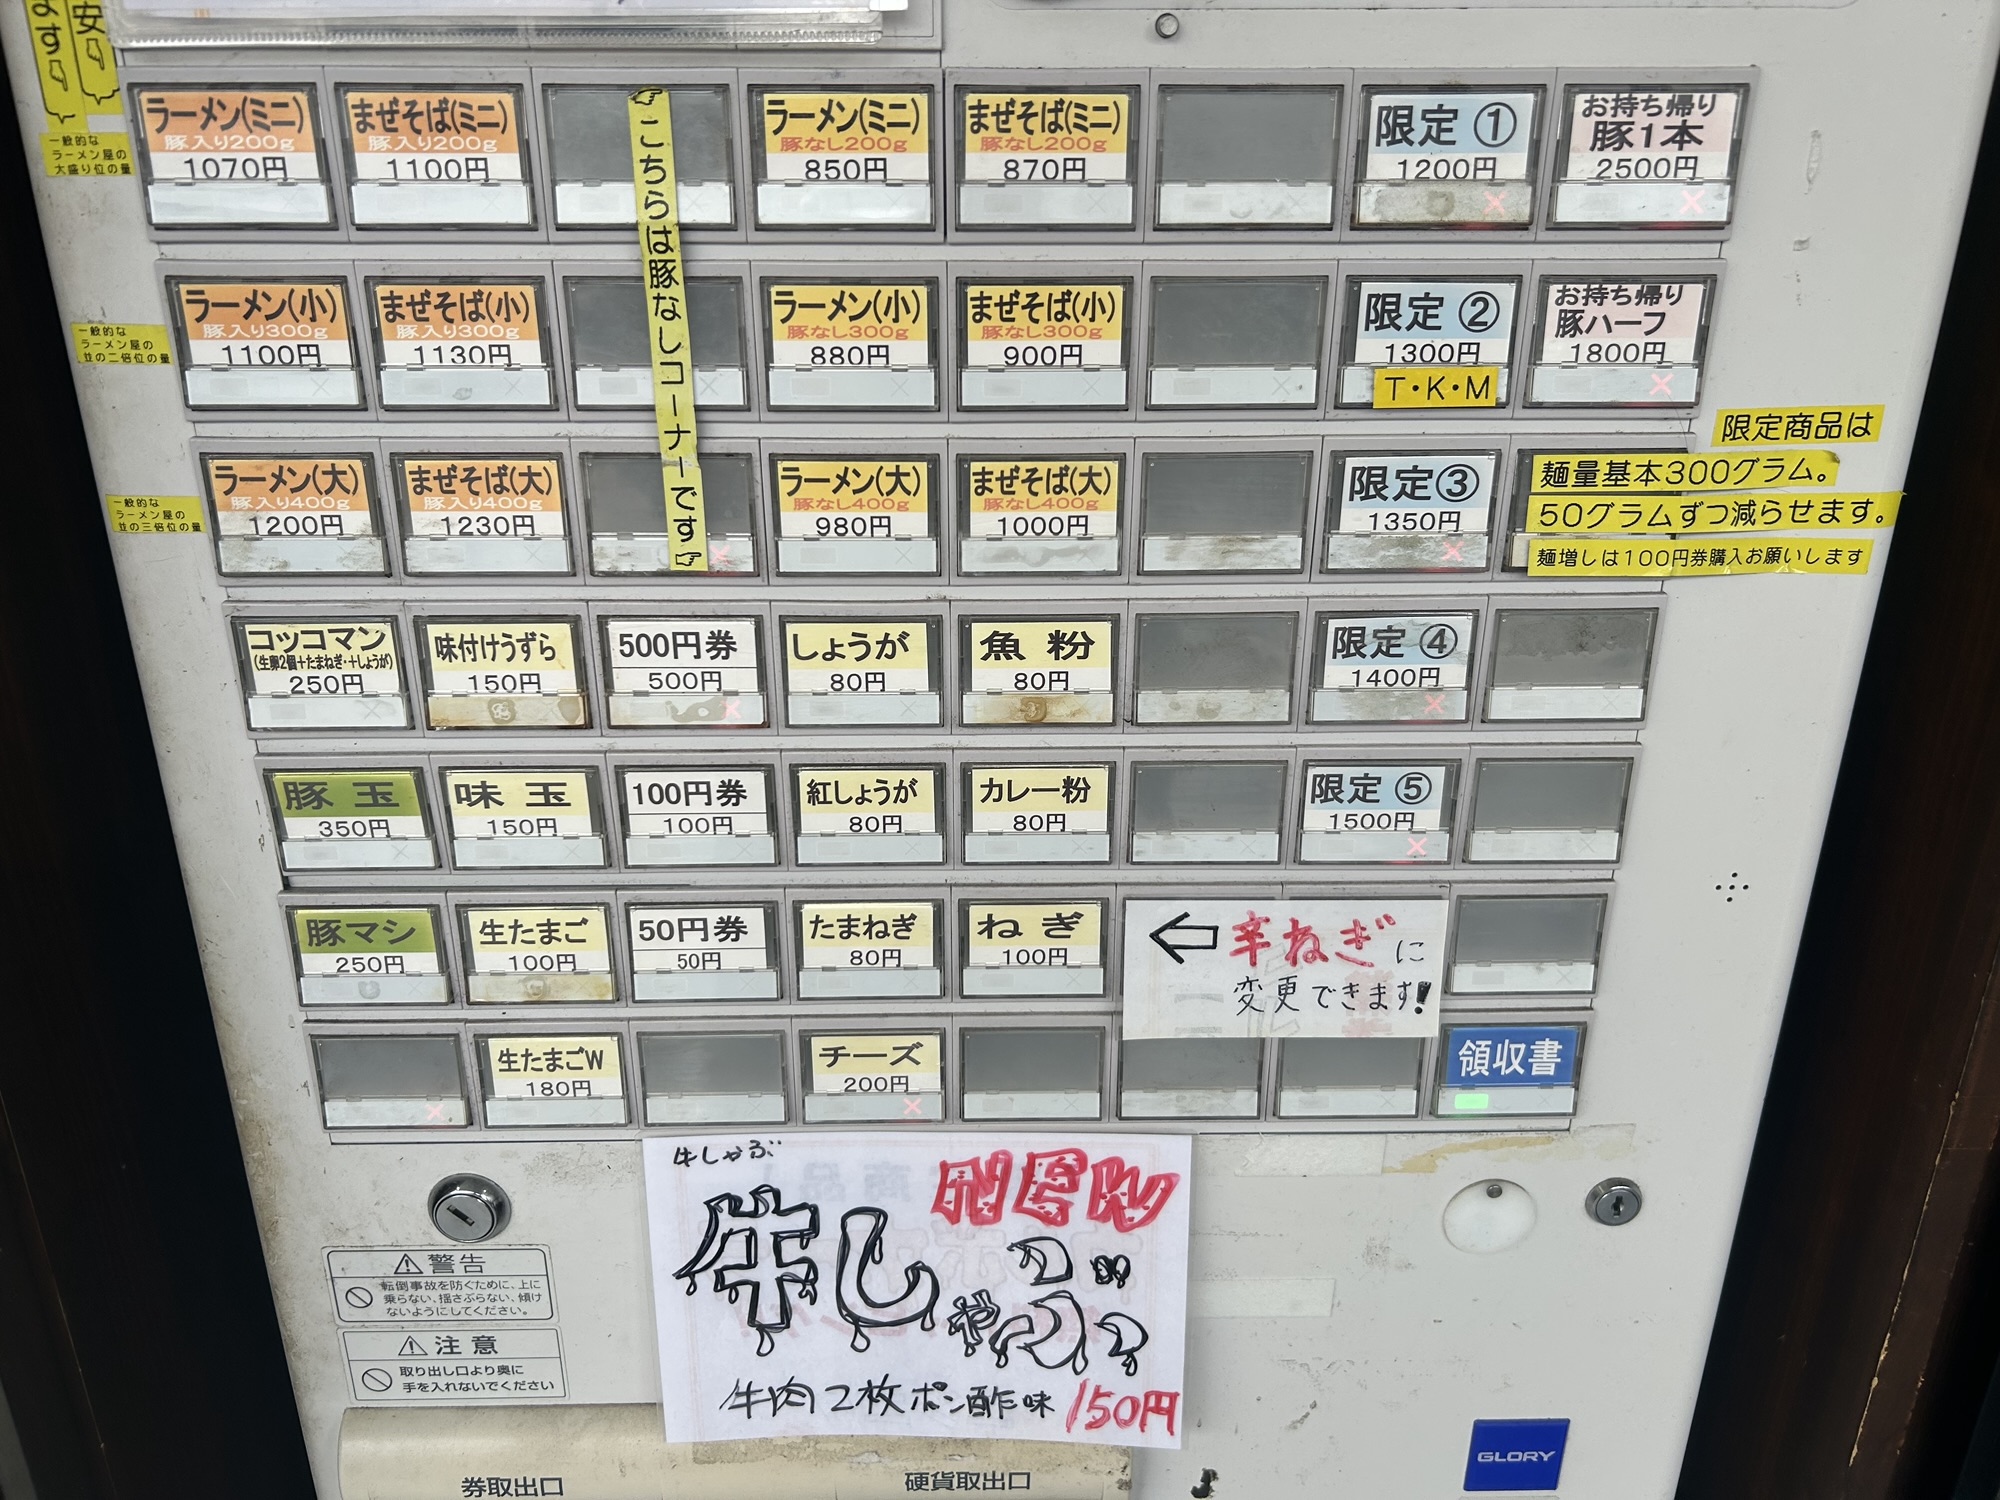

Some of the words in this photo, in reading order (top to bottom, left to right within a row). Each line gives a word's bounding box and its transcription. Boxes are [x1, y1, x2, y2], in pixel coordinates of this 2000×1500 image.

[146, 97, 304, 134] ラーメン(ミニ)
[351, 96, 507, 134] まぜそば(ミニ)
[766, 98, 920, 136] ラーメン(ミニ)
[968, 98, 1121, 135] まぜそば(ミニ)
[1581, 94, 1717, 118] お持ち帰り
[49, 135, 99, 146] 一般的な
[164, 135, 295, 152] 豚入り200g
[368, 135, 498, 152] 豚入り200g
[780, 136, 908, 152] 豚なし200g
[980, 136, 1107, 152] 豚なし200g
[1590, 120, 1704, 151] 豚1本
[52, 149, 127, 160] ラーメン屋の
[55, 163, 132, 175] 大盛り位の量
[183, 157, 288, 180] 1070円
[387, 157, 489, 181] 1100円
[804, 157, 888, 181] 850円
[1003, 157, 1086, 181] 870円
[1396, 156, 1497, 181] 1200円
[1596, 156, 1698, 181] 2500円
[185, 289, 337, 324] ラーメン(小)
[380, 289, 529, 323] まぜそば(小)
[971, 289, 1115, 324] まぜそば(小)
[1554, 284, 1684, 307] お持ち帰り
[774, 290, 920, 324] ラーメン(小)
[79, 326, 126, 336] 一般的な
[203, 324, 328, 340] 豚入り300g
[396, 324, 520, 339] 豚入り300g
[639, 118, 699, 543] こちらは豚なしコーナーです
[787, 325, 909, 340] 豚なし300g
[981, 325, 1102, 340] 豚なし300g
[1555, 309, 1666, 338] 豚ハーフ
[81, 339, 153, 350] ラーメン屋の
[221, 344, 321, 366] 1100円
[413, 344, 512, 366] 1130円
[810, 344, 890, 366] 880円
[1003, 344, 1083, 366] 900円
[1384, 342, 1481, 364] 1300円
[1569, 342, 1666, 364] 1800円
[1721, 411, 1874, 442] 限定商品は
[214, 464, 359, 495] ラーメン(大)
[409, 464, 552, 496] まぜそば(大)
[780, 465, 921, 497] ラーメン(大)
[972, 465, 1111, 496] まぜそば(大)
[114, 498, 159, 507] 一般的な
[231, 495, 350, 511] 豚入り400g
[424, 496, 543, 511] 豚入り400g
[793, 497, 909, 511] 豚なし400g
[983, 497, 1099, 511] 豚なし400g
[1539, 498, 1885, 529] 50グラムずつ減らせます。
[116, 510, 185, 520] ラーメン屋の
[250, 514, 344, 536] 1200円
[441, 514, 535, 536] 1230円
[815, 515, 891, 537] 980円
[997, 515, 1088, 536] 1000円
[1367, 510, 1461, 532] 1350円
[248, 626, 386, 653] コッコマン
[435, 632, 556, 662] 味付けうずら
[619, 629, 738, 661] 500円券
[792, 631, 911, 662] しょうが
[289, 674, 364, 694] 250円
[467, 673, 542, 694] 150円
[648, 671, 722, 692] 500円
[829, 672, 886, 692] 80円
[1013, 670, 1069, 692] 80円
[1350, 666, 1441, 688] 1400円
[632, 778, 747, 807] 100円券
[806, 778, 918, 806] 紅しょうが
[980, 776, 1091, 804] カレー粉
[318, 819, 390, 838] 350円
[487, 818, 558, 837] 150円
[663, 816, 733, 835] 100円
[849, 815, 902, 834] 80円
[1013, 813, 1066, 832] 80円
[1329, 811, 1415, 830] 1500円
[306, 918, 416, 947] 豚マシ
[479, 917, 589, 945] 生たまご
[638, 914, 749, 944] 50円券
[809, 913, 918, 940] たまねぎ
[335, 955, 405, 974] 250円
[508, 954, 577, 972] 100円
[676, 952, 721, 970] 50円
[849, 949, 902, 967] 80円
[1002, 948, 1068, 966] 100円
[497, 1047, 603, 1073] 生たまごW
[818, 1041, 924, 1068] チーズ
[1458, 1038, 1563, 1077] 領収書
[525, 1080, 591, 1097] 180円
[843, 1076, 909, 1093] 200円
[427, 1253, 486, 1274] 警告
[386, 1306, 528, 1317] ないようにしてください。
[435, 1335, 498, 1355] 注意
[399, 1364, 524, 1377] 取り出し口より奥に
[402, 1380, 555, 1394] 手を入れないでください
[1065, 1377, 1180, 1436] 150円
[1477, 1450, 1555, 1463] GLORY
[461, 1477, 564, 1498] 券取出口
[904, 1470, 1032, 1492] 硬貨取出口
